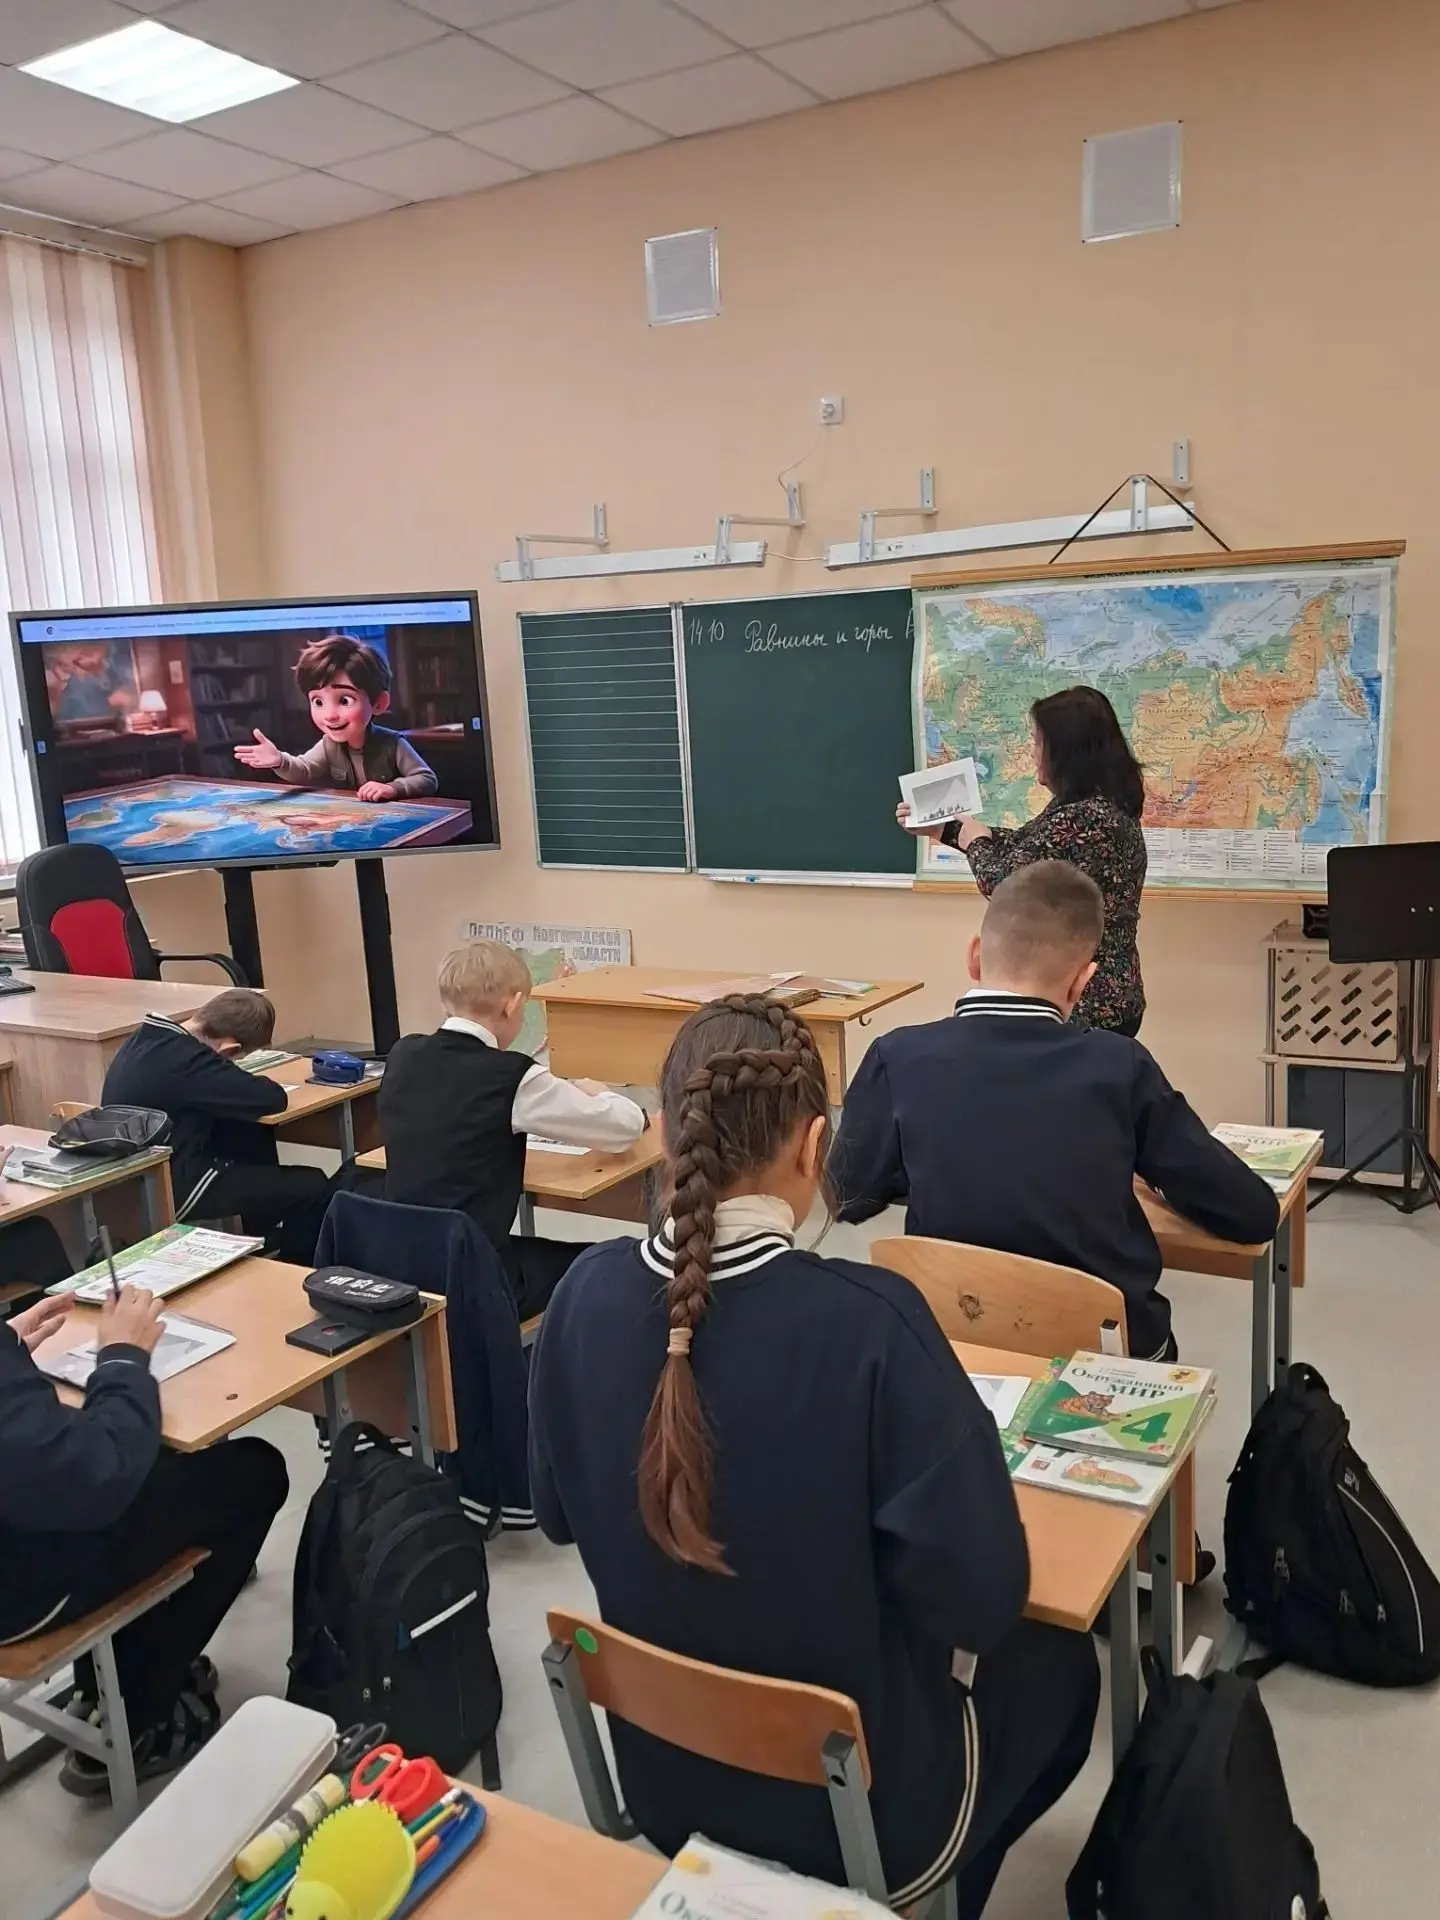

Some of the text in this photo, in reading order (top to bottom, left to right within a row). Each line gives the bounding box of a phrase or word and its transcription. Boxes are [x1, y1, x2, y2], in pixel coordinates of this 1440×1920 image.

[688, 617, 893, 653] 14 10 Равнины и горы
[572, 946, 621, 963] ОБЛАСТИ
[1071, 1367, 1184, 1392] Окружающий
[1120, 1411, 1172, 1444] 4
